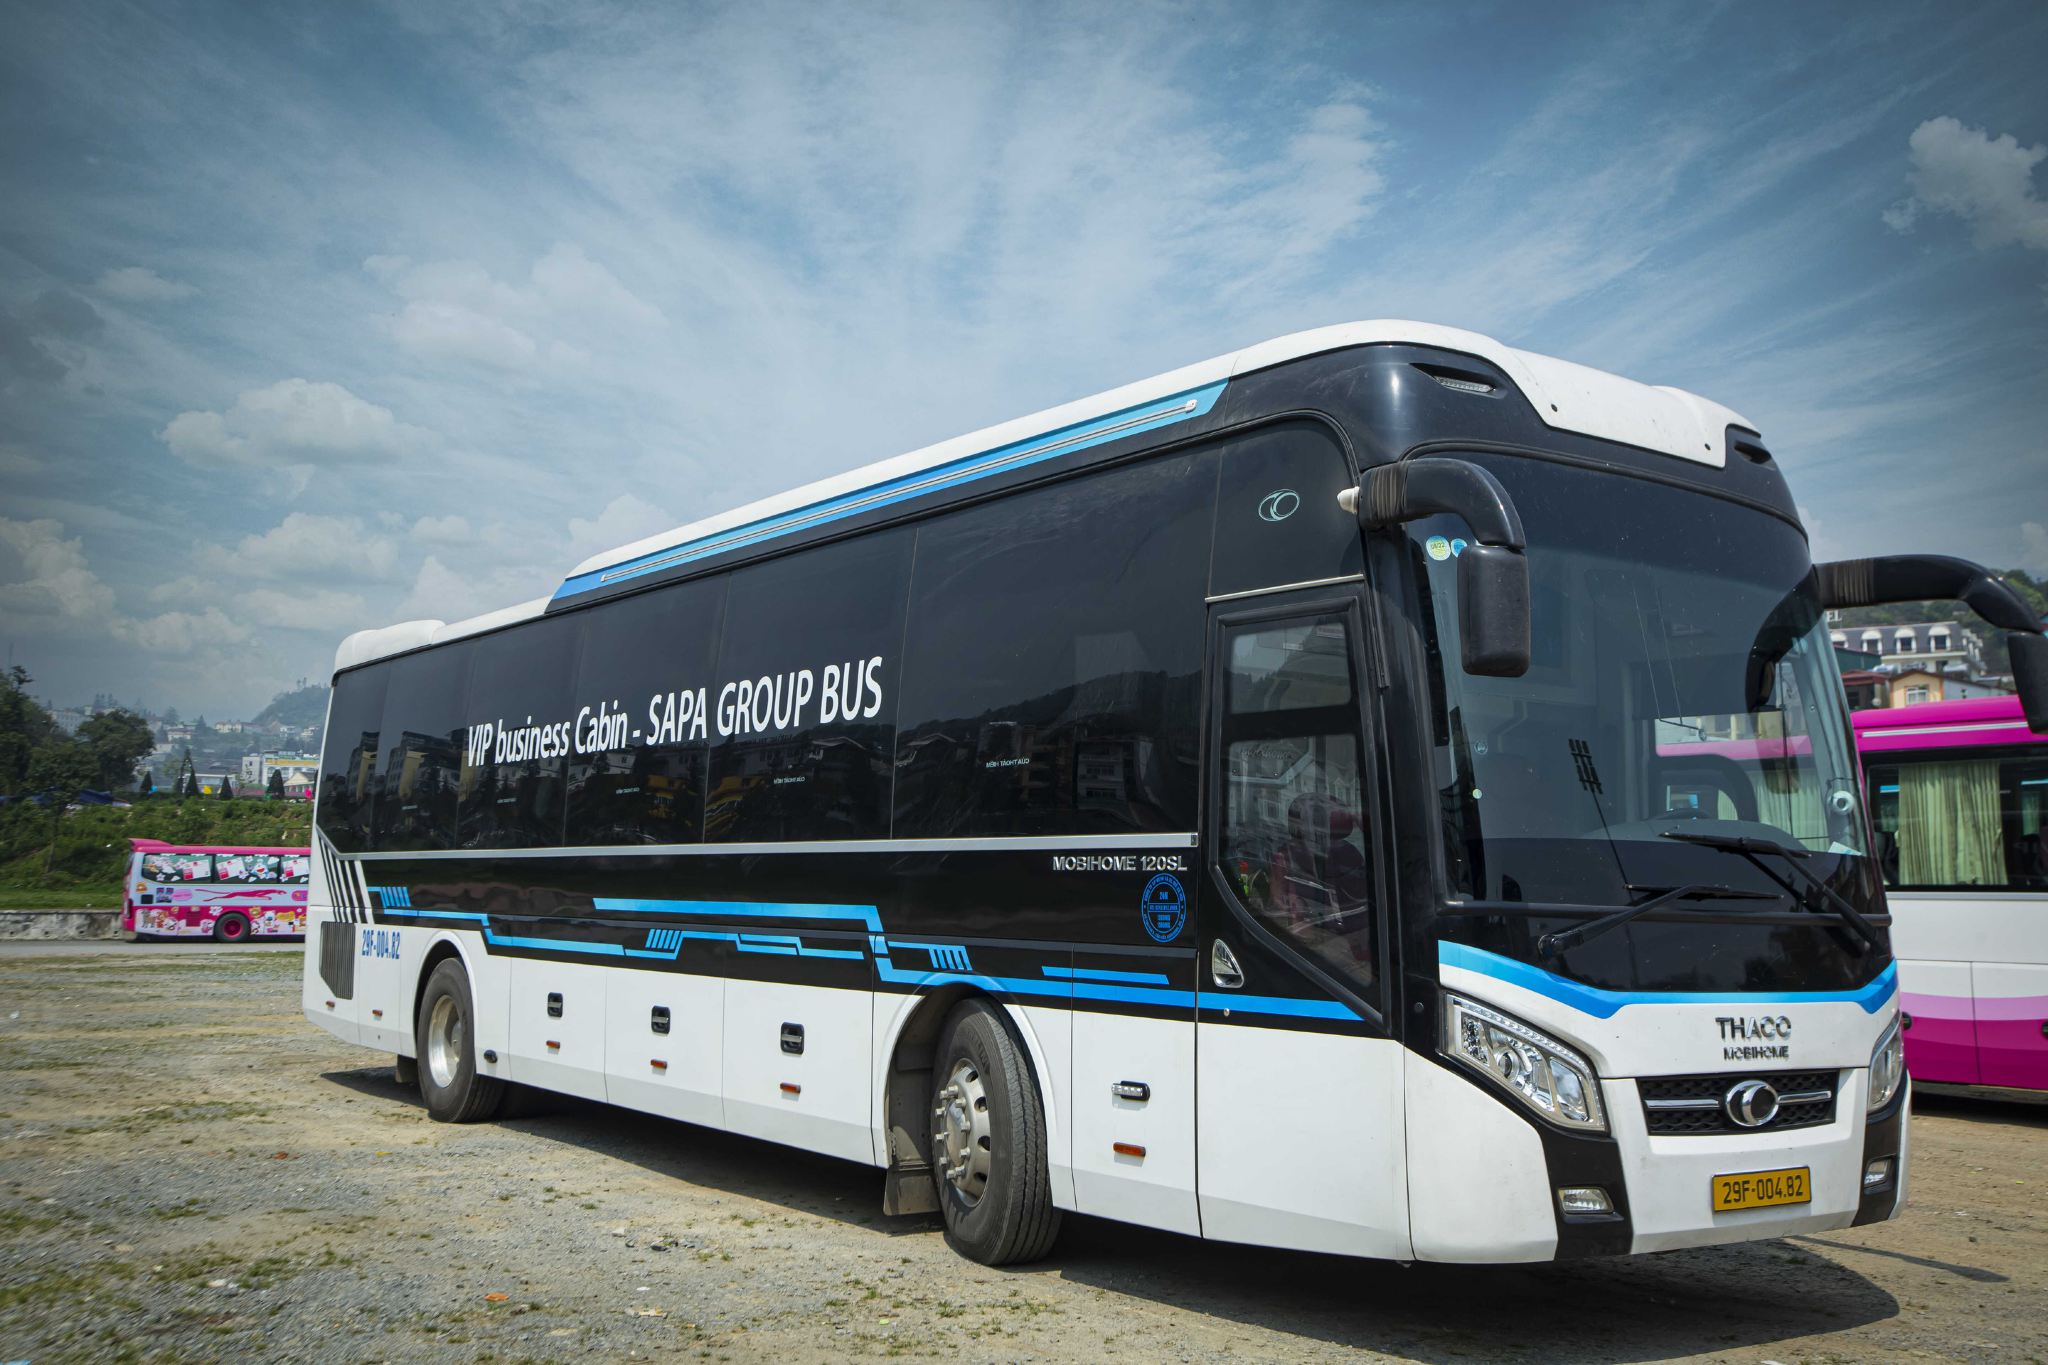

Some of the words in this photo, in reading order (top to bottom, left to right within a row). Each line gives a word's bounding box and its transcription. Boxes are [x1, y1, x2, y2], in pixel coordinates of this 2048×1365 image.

[468, 723, 493, 767] VIP
[495, 716, 570, 764] business
[575, 700, 628, 755] Cabin
[632, 728, 639, 738] -
[646, 687, 708, 746] SAPA
[717, 669, 813, 737] GROUP
[820, 656, 882, 724] BUS
[1052, 855, 1137, 871] MOBIHOME
[1140, 855, 1188, 871] 120SL
[362, 929, 401, 960] 29F-004.82
[1715, 1015, 1792, 1040] THACO
[1723, 1045, 1789, 1061] MOBIHOME
[1722, 1174, 1803, 1204] 29F-004.82
